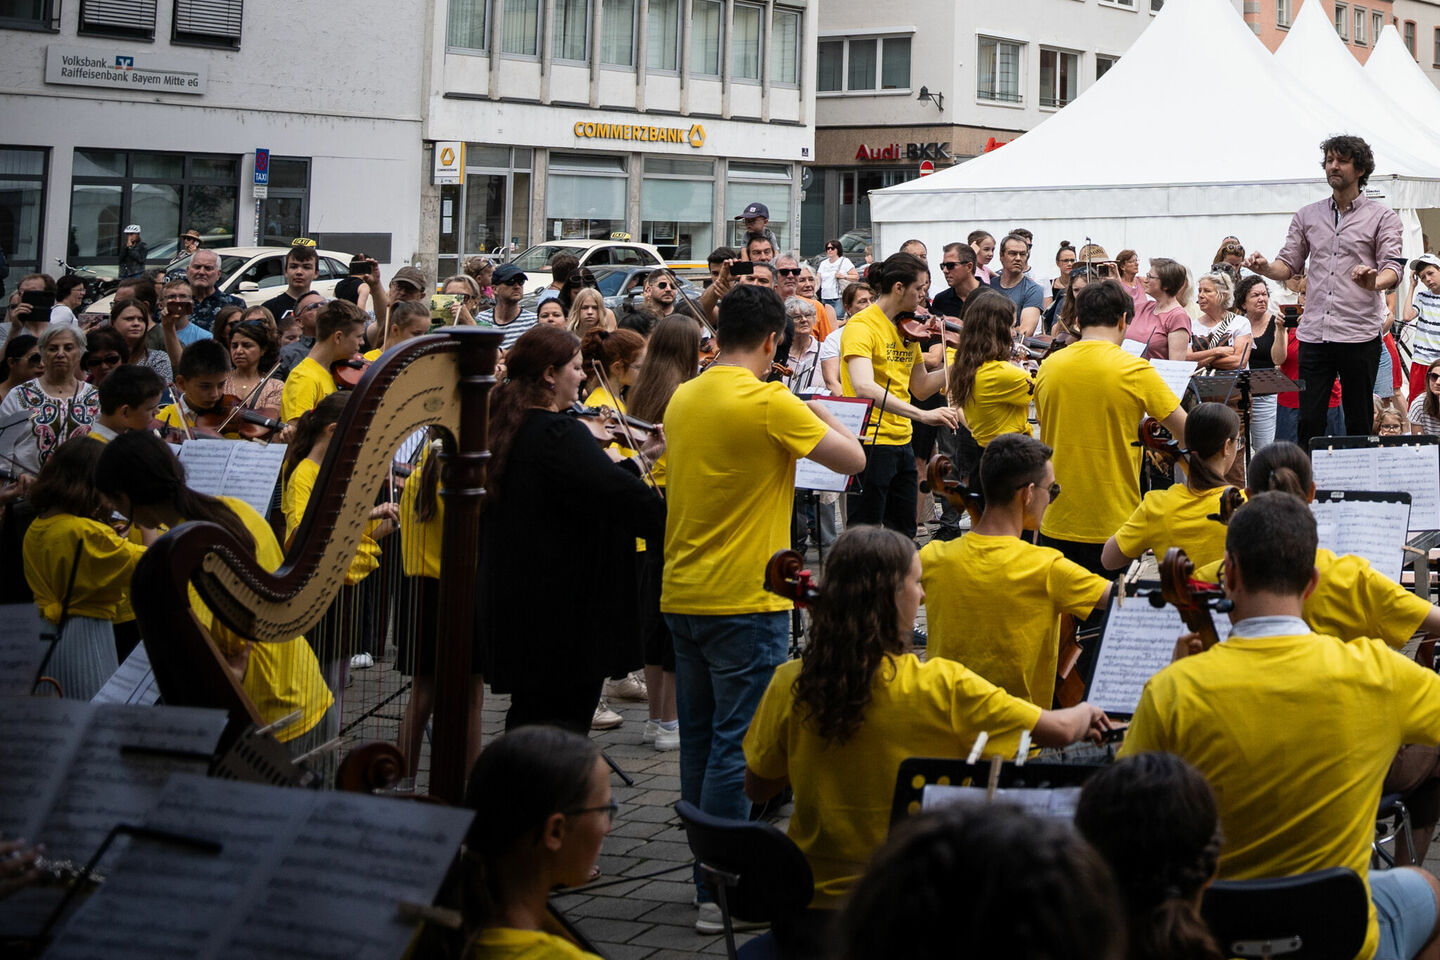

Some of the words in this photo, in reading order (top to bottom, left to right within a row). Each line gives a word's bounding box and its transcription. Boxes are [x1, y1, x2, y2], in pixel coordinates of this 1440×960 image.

[62, 55, 107, 68] Volksbank
[61, 67, 128, 82] Raiffeisenbank
[132, 73, 161, 85] Bayern
[163, 75, 185, 86] Mitte
[187, 78, 199, 87] eG
[574, 121, 686, 143] COMMERZBANK
[855, 143, 901, 161] Audi
[906, 142, 951, 159] BKK
[255, 172, 268, 181] TAXI
